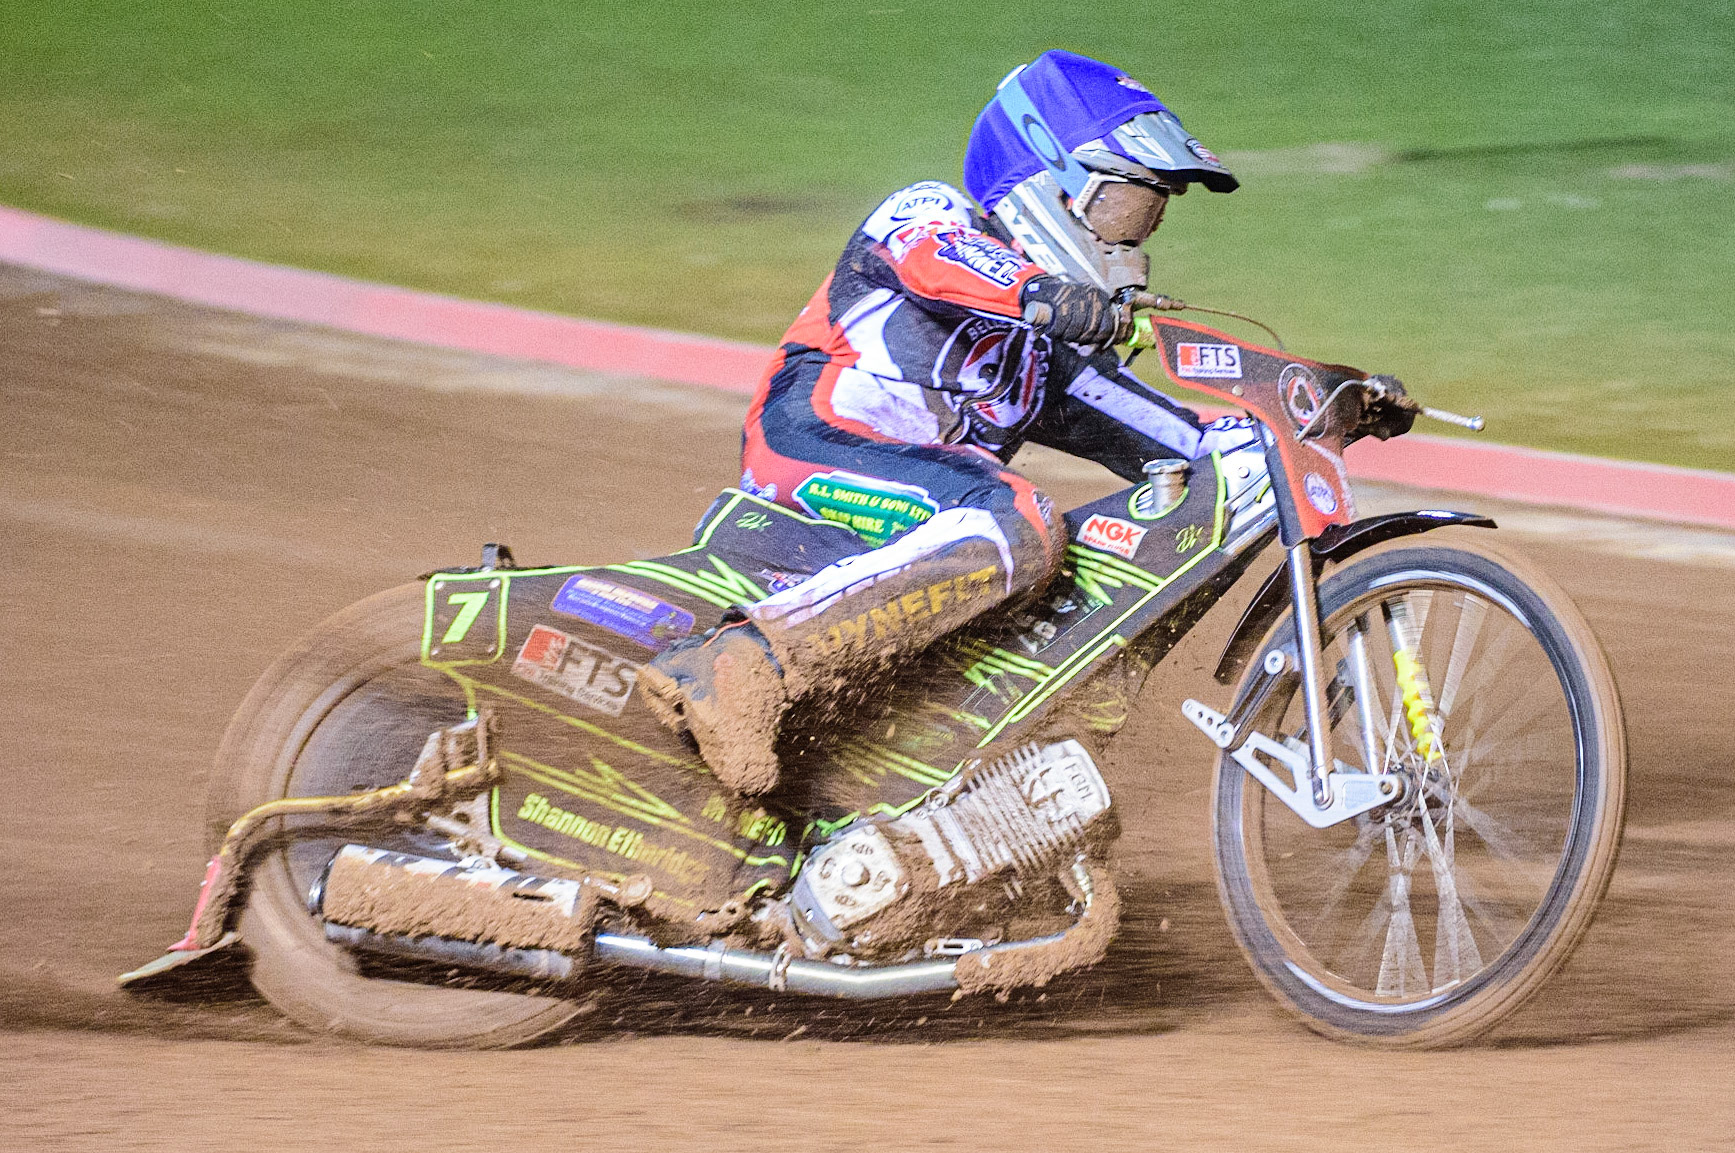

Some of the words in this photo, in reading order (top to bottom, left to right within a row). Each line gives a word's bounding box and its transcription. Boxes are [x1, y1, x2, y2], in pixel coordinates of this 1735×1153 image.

[1199, 346, 1236, 367] FTS
[832, 488, 871, 507] SMITH
[1086, 518, 1141, 546] NGK
[442, 591, 490, 644] 7
[557, 640, 638, 698] FTS
[517, 793, 612, 849] Shannon
